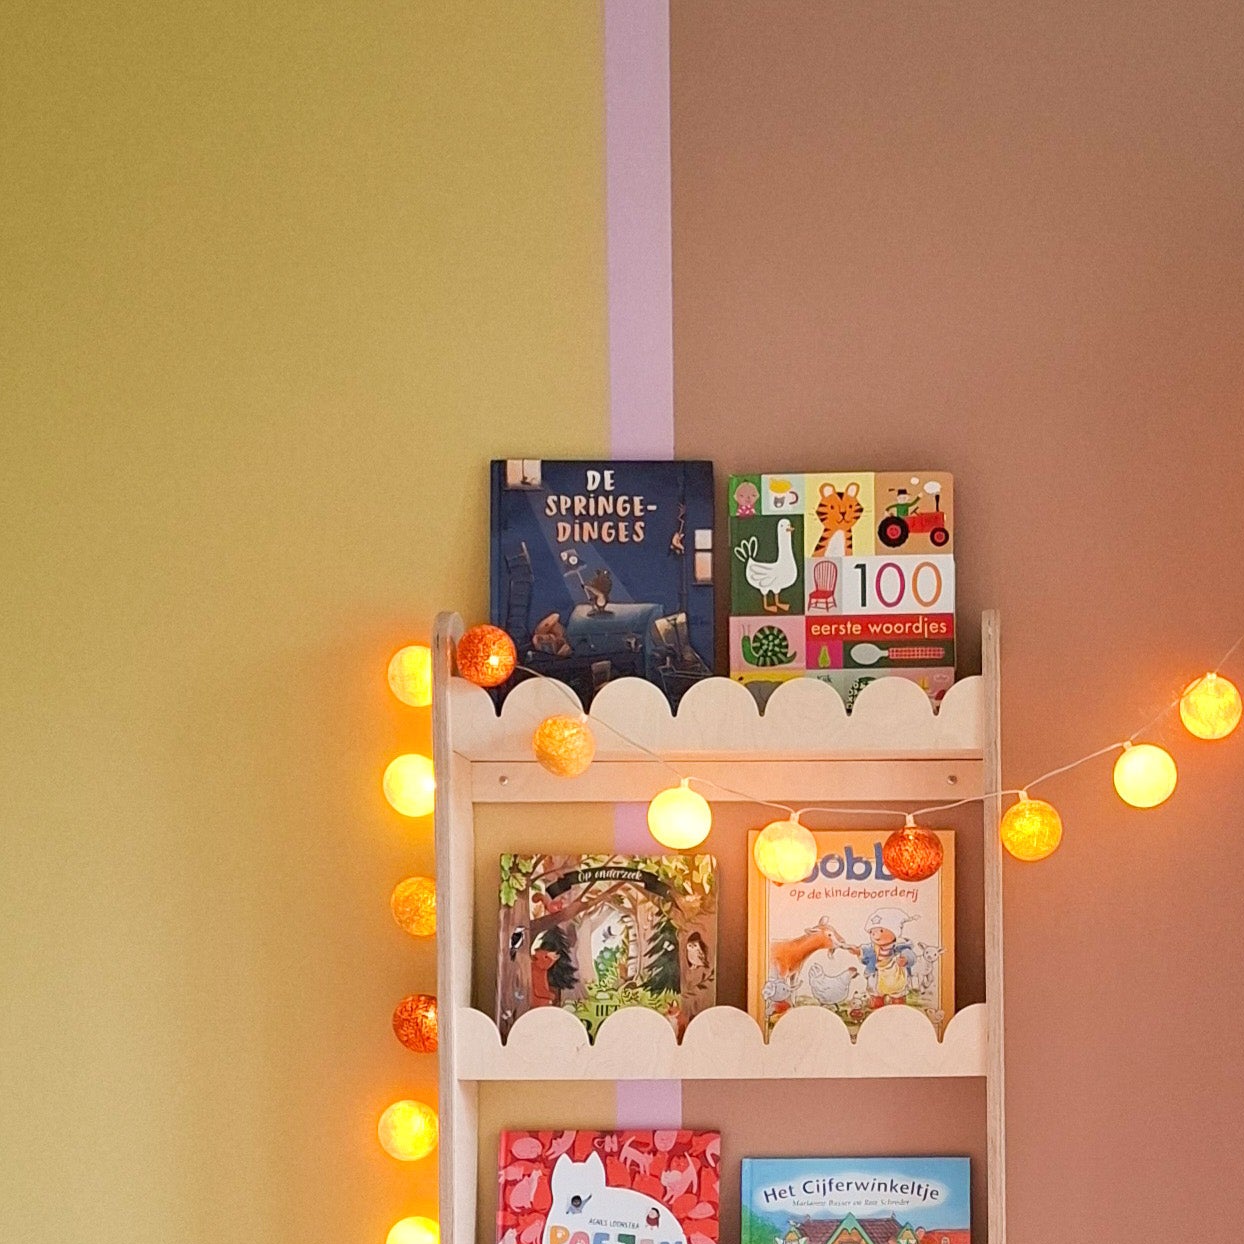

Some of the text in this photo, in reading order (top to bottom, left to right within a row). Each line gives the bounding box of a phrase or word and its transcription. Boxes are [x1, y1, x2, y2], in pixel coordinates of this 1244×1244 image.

[586, 469, 615, 491] DE
[557, 519, 645, 543] DINGES
[854, 561, 942, 608] 100
[811, 615, 947, 638] eerste woordjes
[789, 886, 919, 903] op de kinderboerderij
[764, 1177, 940, 1203] Het Cijferwinkeltje
